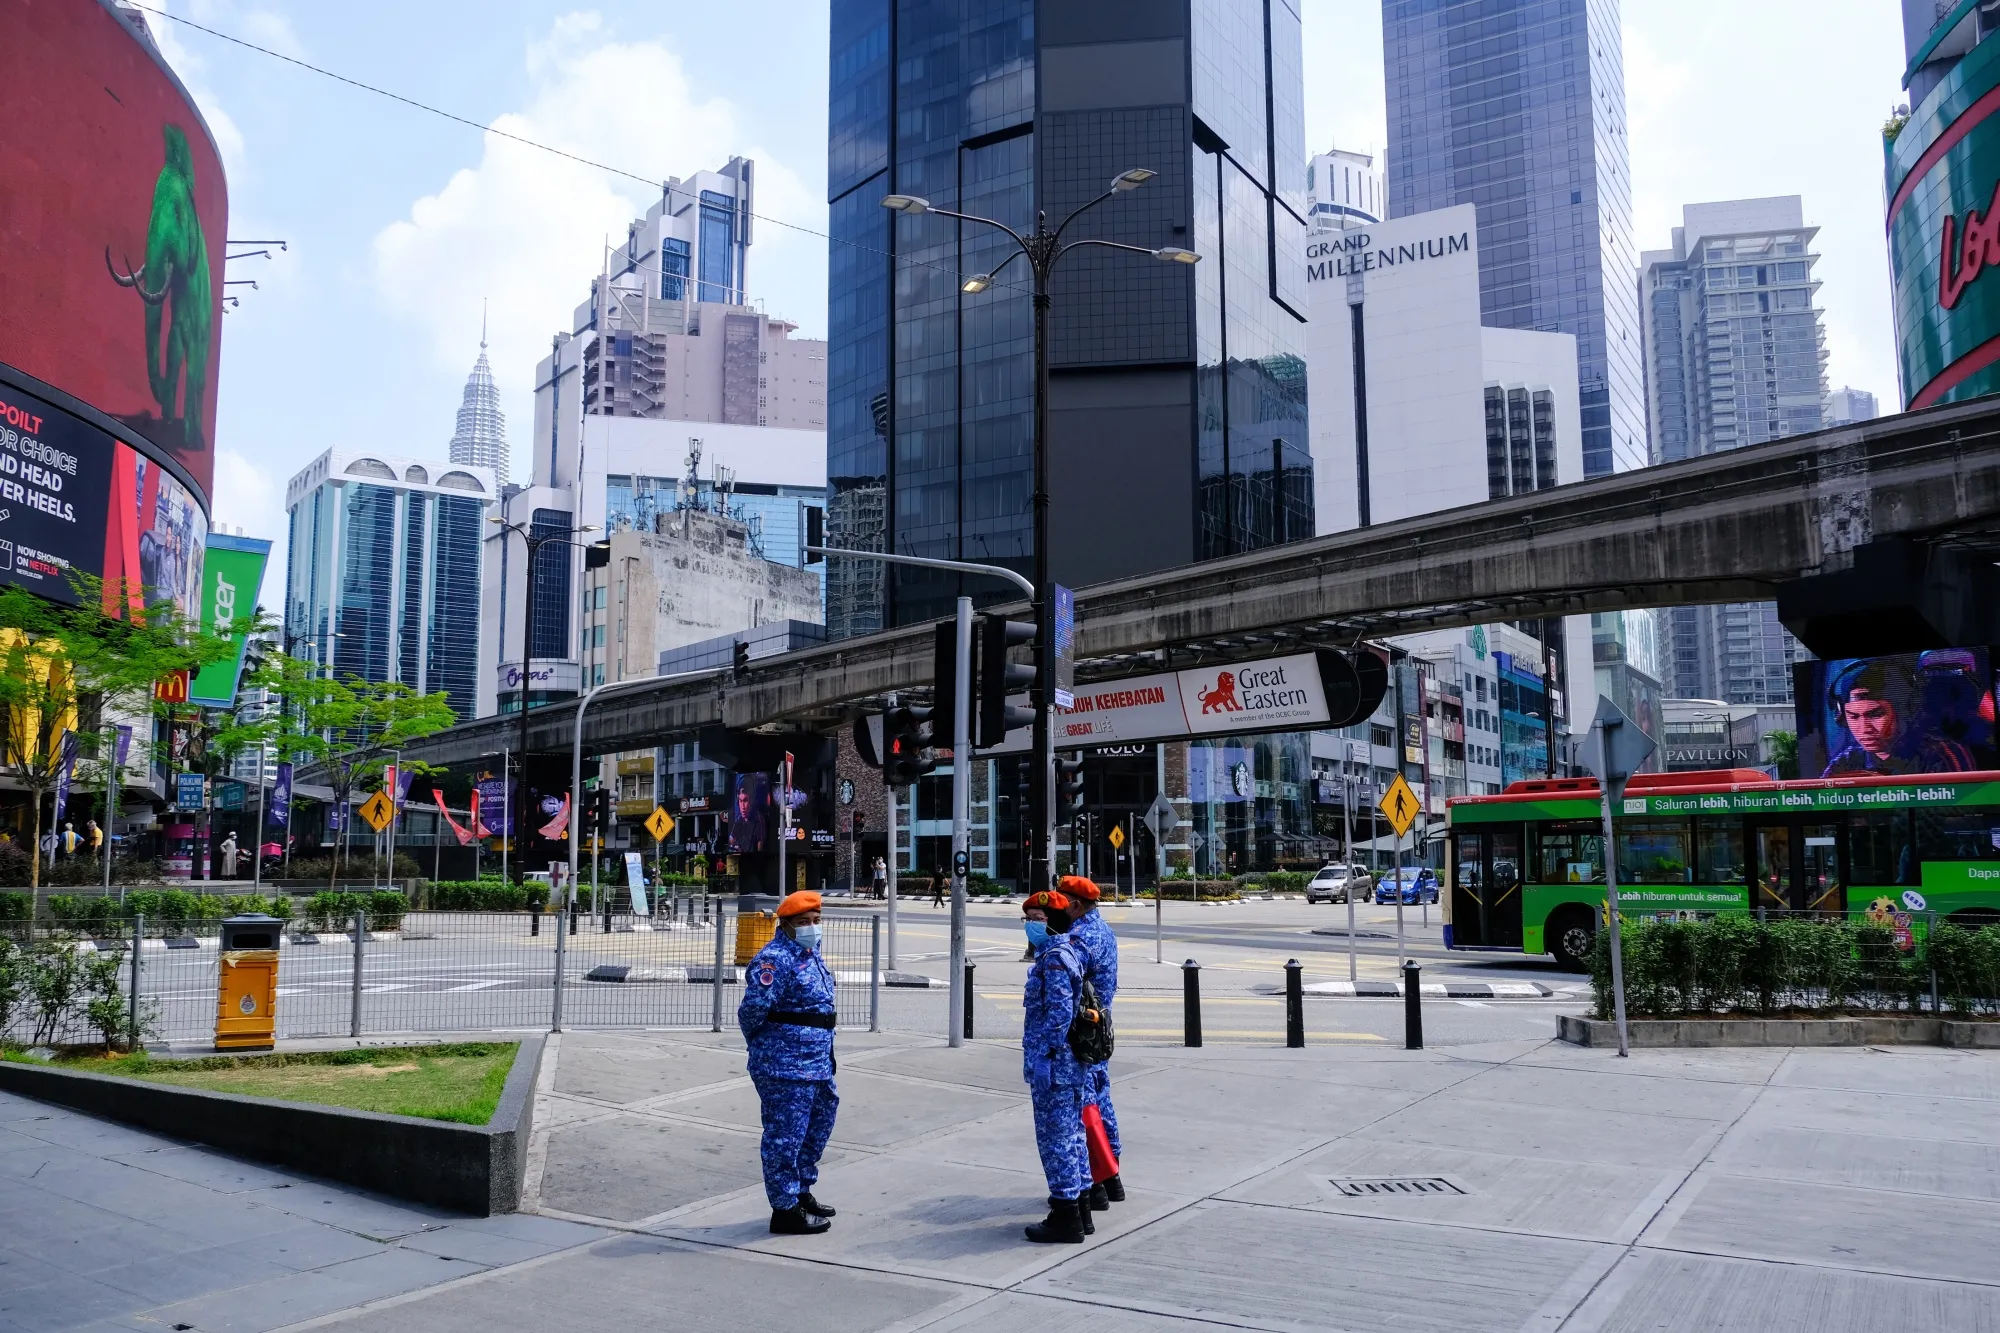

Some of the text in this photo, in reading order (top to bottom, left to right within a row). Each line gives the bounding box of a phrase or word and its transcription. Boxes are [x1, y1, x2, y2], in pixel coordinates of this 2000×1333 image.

[1306, 233, 1371, 258] GRAND
[1307, 232, 1469, 283] MILLENNIUM
[20, 436, 78, 476] CHOICE
[20, 461, 63, 492] HEAD
[26, 488, 77, 523] HEELS.
[16, 555, 59, 577] ON NETFLIX
[17, 544, 70, 569] NOW SHOWING
[1238, 665, 1288, 690] Great
[1095, 686, 1166, 711] KEHEBATAN
[1242, 688, 1308, 711] Eastern
[1234, 714, 1257, 722] member
[1257, 713, 1264, 721] of
[1264, 711, 1275, 720] the
[1275, 710, 1292, 718] OCBC
[1292, 709, 1311, 718] Group
[1066, 722, 1094, 737] GREAT
[1094, 720, 1114, 734] LIFE
[1666, 749, 1748, 761] PAVILION
[1655, 799, 1697, 811] Saluran
[1700, 796, 1731, 809] lebih,
[1733, 795, 1779, 808] hiburan
[1782, 794, 1815, 807] lebih,
[1818, 792, 1855, 806] hidup
[1857, 787, 1956, 803] terlebih-lebih!
[1968, 867, 2000, 880] Dapa
[1617, 891, 1742, 902] Lebih hiburan untuk semua!
